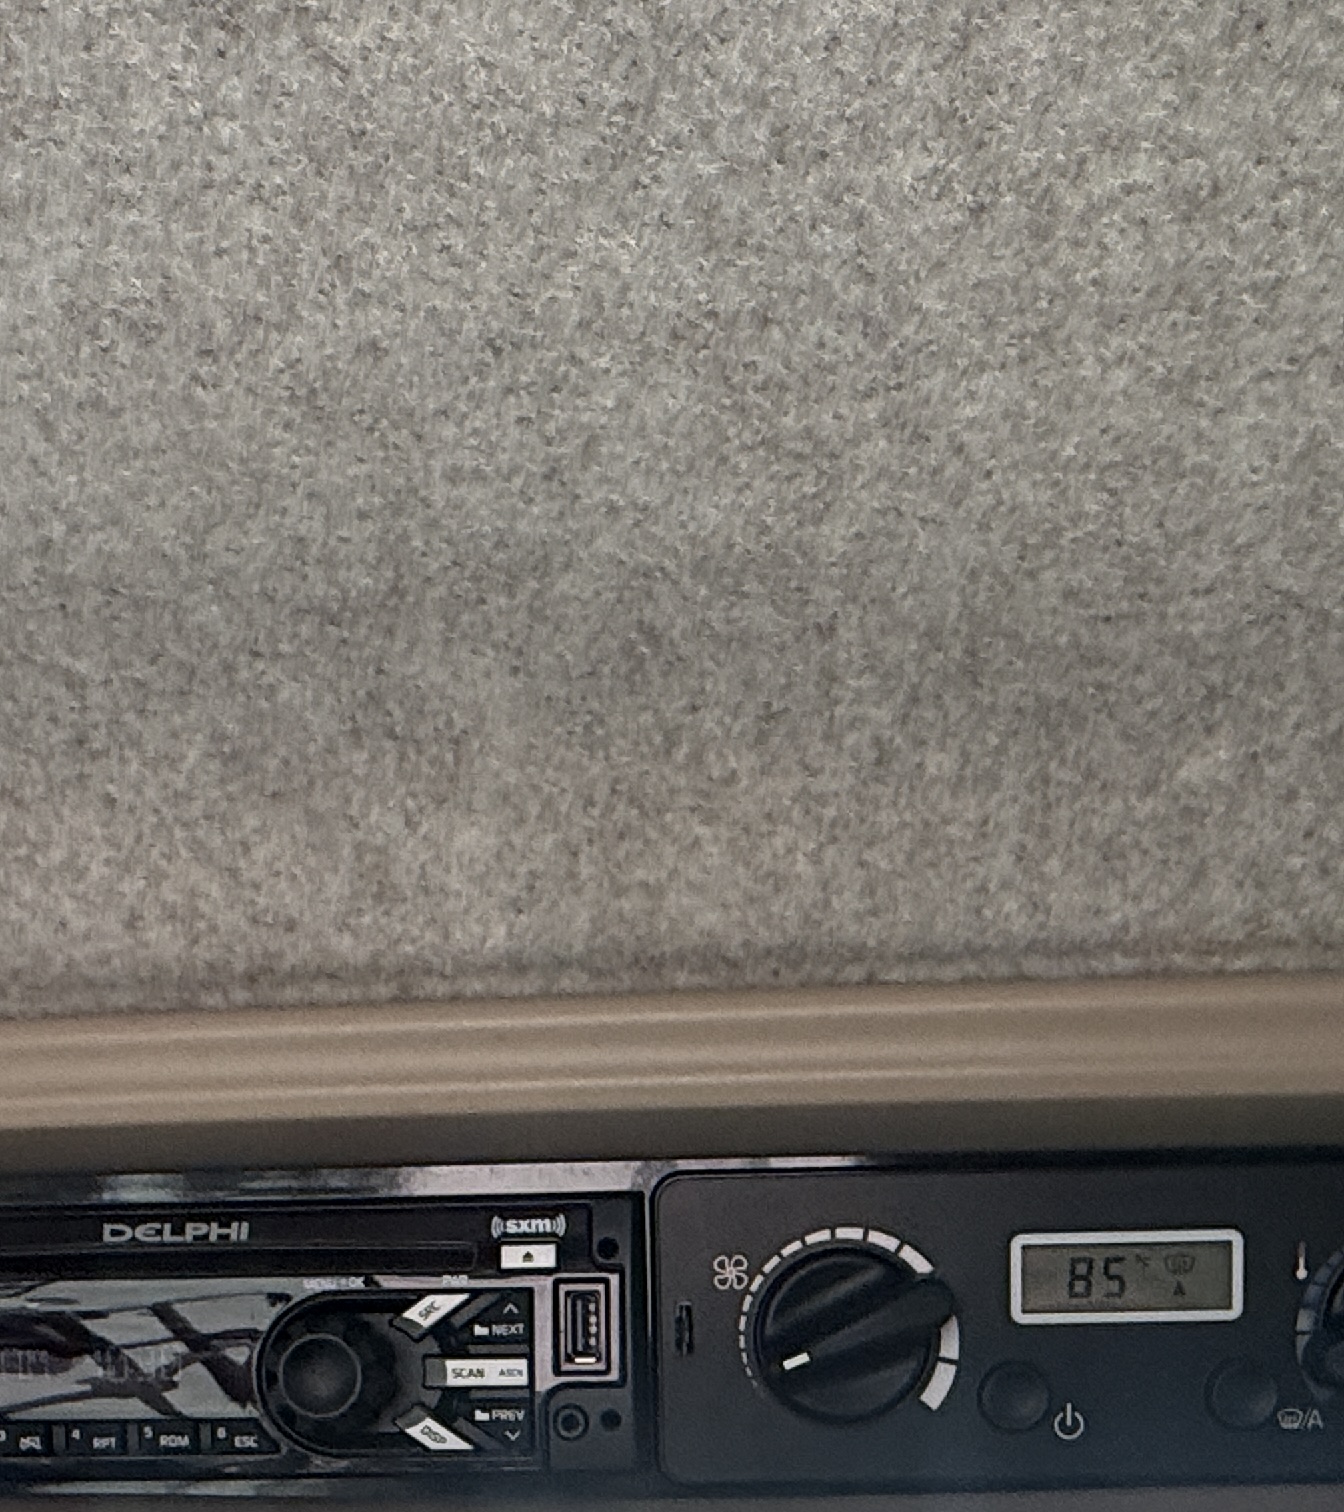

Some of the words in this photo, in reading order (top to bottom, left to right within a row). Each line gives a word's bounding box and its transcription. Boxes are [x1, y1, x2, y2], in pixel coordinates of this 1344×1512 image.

[102, 1221, 250, 1243] DELPHI
[1068, 1255, 1126, 1298] 85
[492, 1323, 524, 1336] NEXT
[451, 1368, 485, 1379] SCAN
[492, 1409, 525, 1421] PREV
[71, 1428, 81, 1440] 4
[143, 1426, 153, 1439] 5
[234, 1435, 258, 1448] ESC
